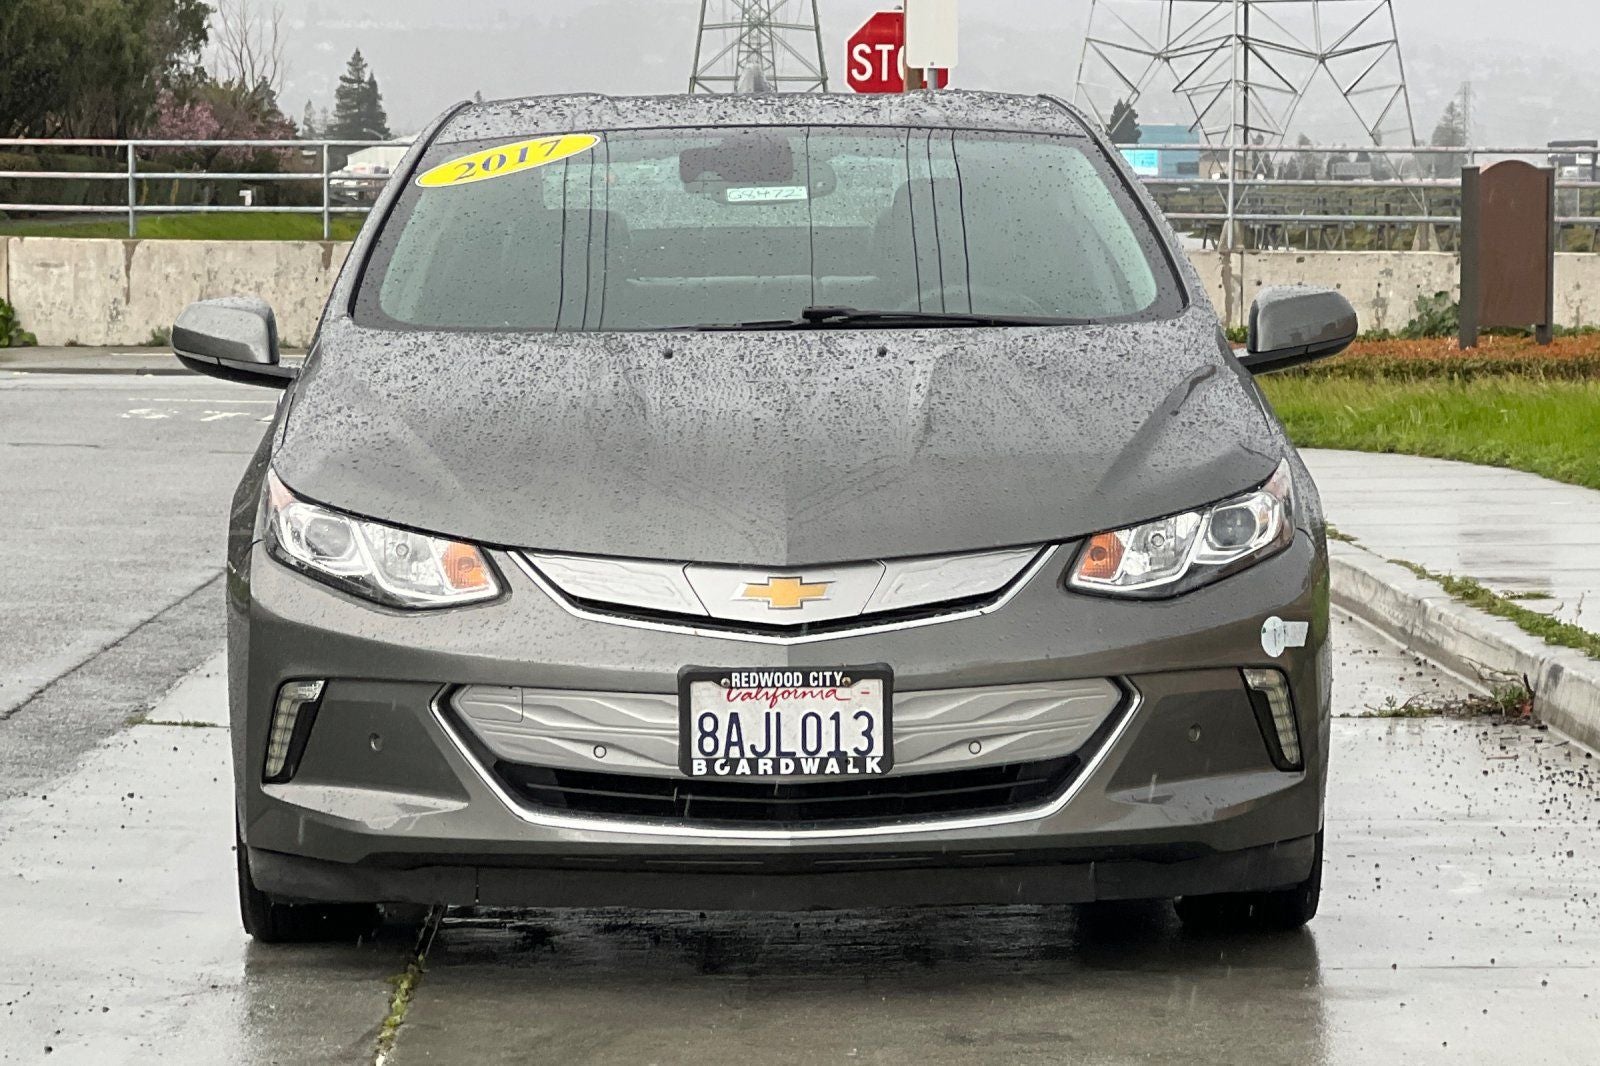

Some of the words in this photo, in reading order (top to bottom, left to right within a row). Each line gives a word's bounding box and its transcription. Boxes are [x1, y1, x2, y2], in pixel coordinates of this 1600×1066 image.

[851, 43, 928, 81] ST
[453, 139, 563, 182] 2017
[731, 671, 803, 688] REDWOOD
[809, 671, 844, 687] CITY
[726, 687, 852, 709] California
[697, 710, 875, 758] 8AJL013
[692, 757, 882, 775] BOARDWALK
